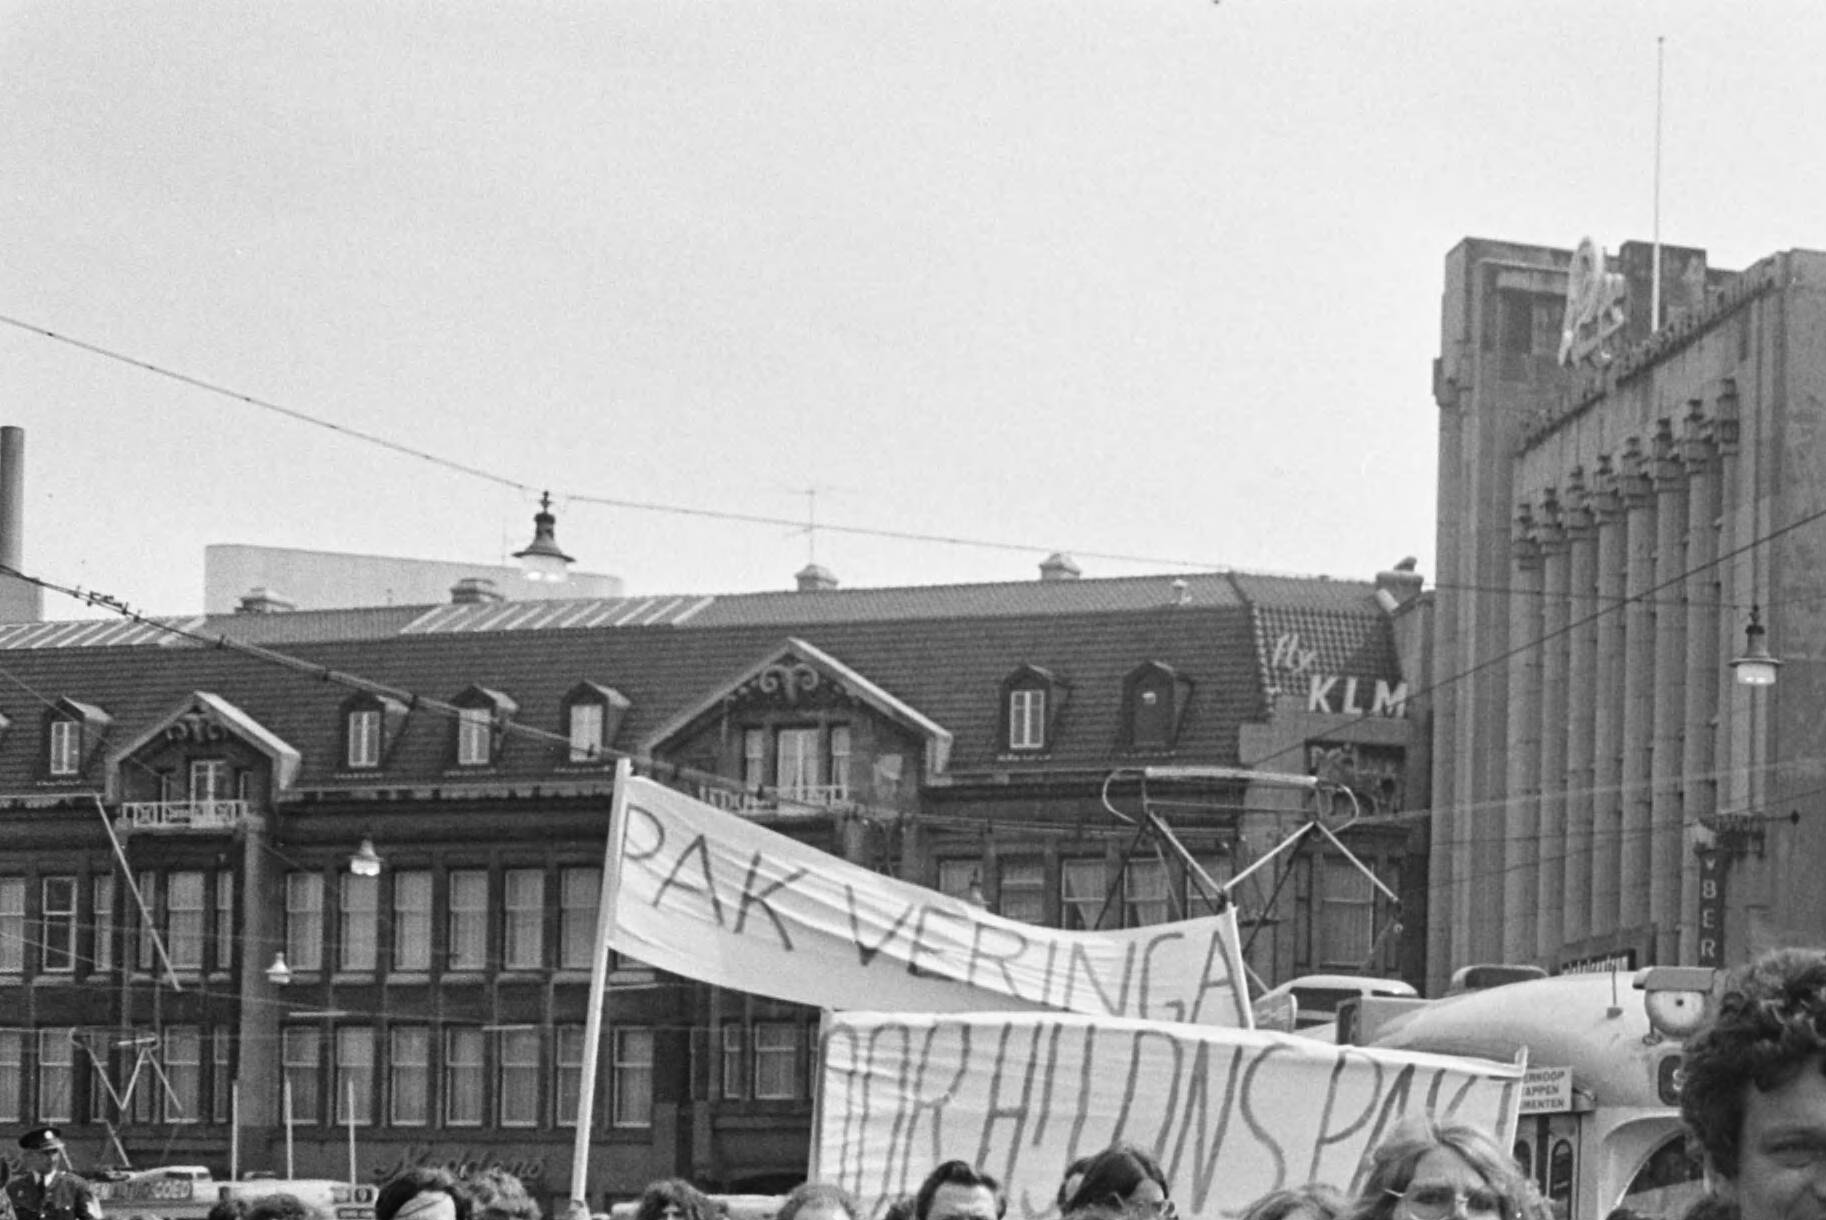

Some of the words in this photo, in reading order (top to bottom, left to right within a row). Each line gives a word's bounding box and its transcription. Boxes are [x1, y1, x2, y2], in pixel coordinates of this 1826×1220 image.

[1271, 632, 1317, 675] fly
[1308, 674, 1408, 718] KLM
[620, 803, 808, 951] PAK
[845, 883, 1248, 1028] VERINGA
